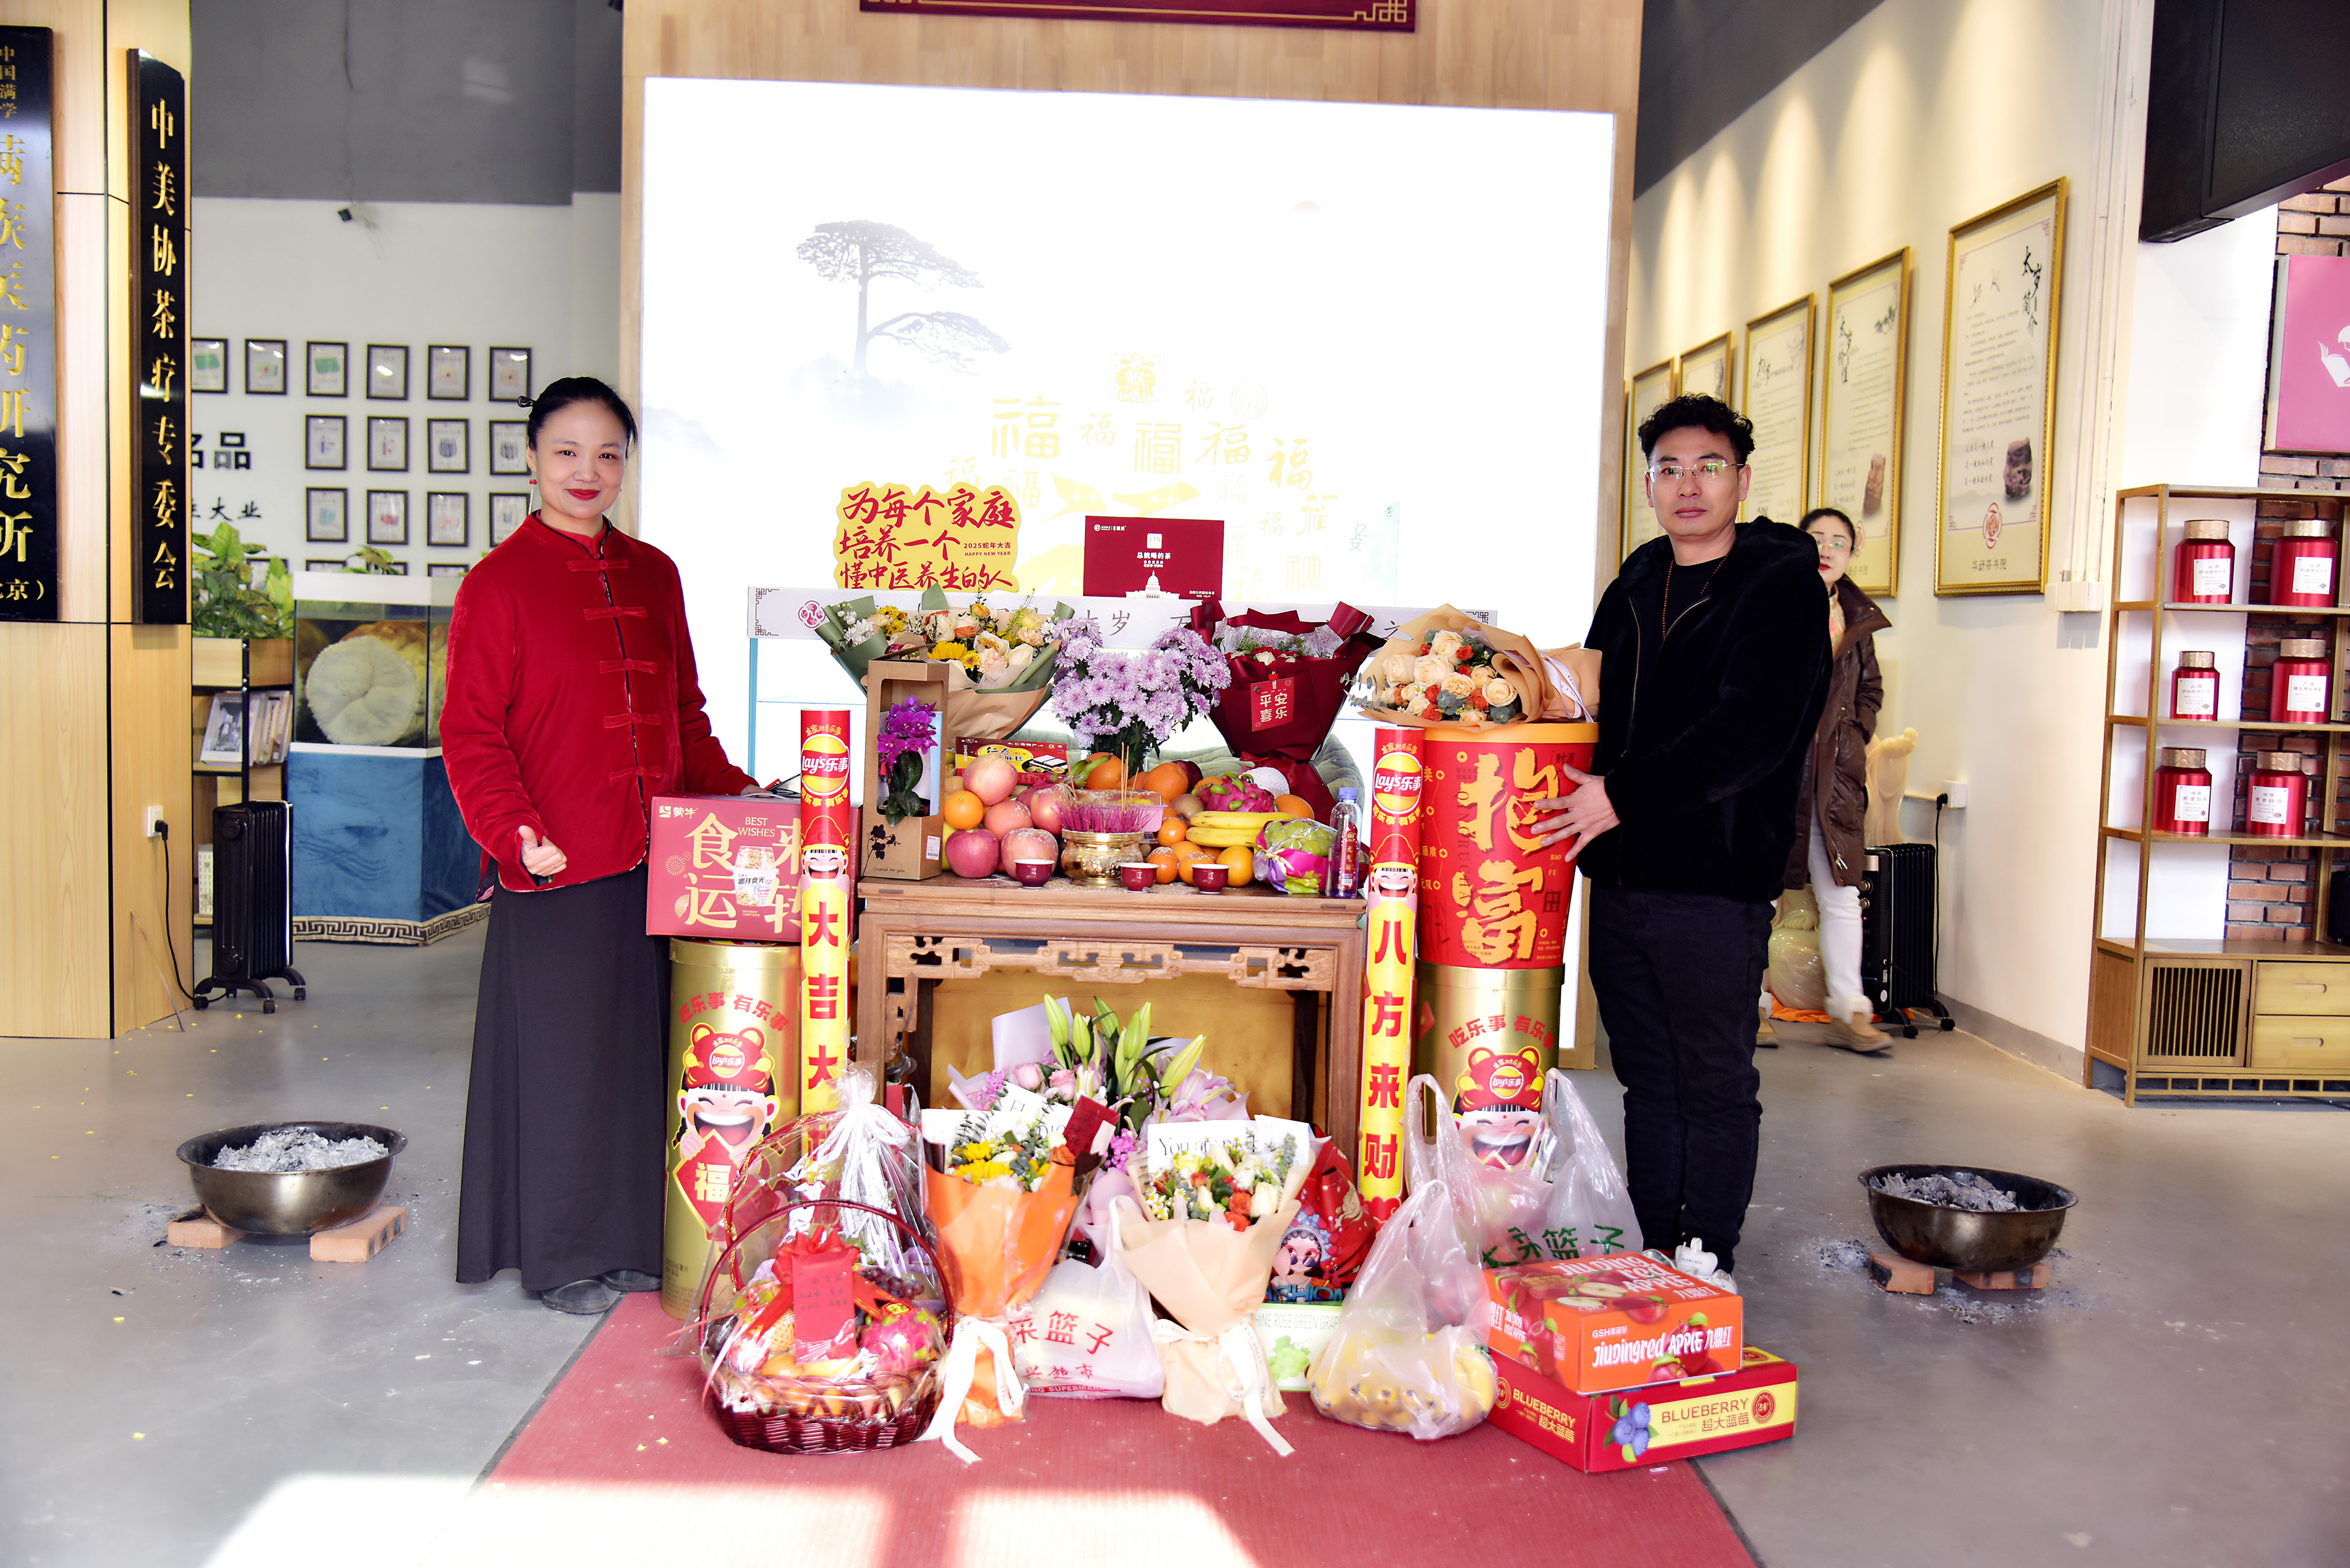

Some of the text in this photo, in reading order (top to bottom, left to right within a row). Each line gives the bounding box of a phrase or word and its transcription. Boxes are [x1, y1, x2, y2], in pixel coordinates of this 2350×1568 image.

[151, 98, 177, 589] 中美协茶疗专委会
[992, 395, 1061, 459] 福
[843, 487, 1016, 529] 为每个家庭
[839, 524, 961, 563] 培养一个
[1136, 551, 1171, 559] 总统喝的茶
[840, 561, 1013, 590] 懂中医养生的人
[1260, 692, 1288, 708] 平安
[1260, 706, 1288, 723] 喜乐
[802, 755, 849, 774] Lay's乐事
[1375, 773, 1422, 792] Lay's乐事
[673, 806, 697, 819] 蒙牛
[745, 817, 768, 826] BEST
[738, 826, 776, 837] WISHES
[679, 992, 789, 1031] 吃乐事 有乐事
[1448, 1014, 1507, 1048] 吃乐事
[1364, 919, 1407, 1179] 八方来财
[712, 1055, 743, 1066] Lay's乐事
[1492, 1077, 1522, 1088] Lay's乐事
[695, 1161, 732, 1202] 福
[1251, 1313, 1272, 1328] HINE
[1274, 1314, 1292, 1328] ROSE
[1294, 1315, 1319, 1329] GREEN
[1023, 1363, 1094, 1379] 兴超市
[1513, 1388, 1576, 1428] BLUEBERRY
[1661, 1398, 1749, 1423] BLUEBERRY
[1539, 1414, 1574, 1443] 超大蓝莓
[1701, 1412, 1749, 1432] 超大蓝莓
